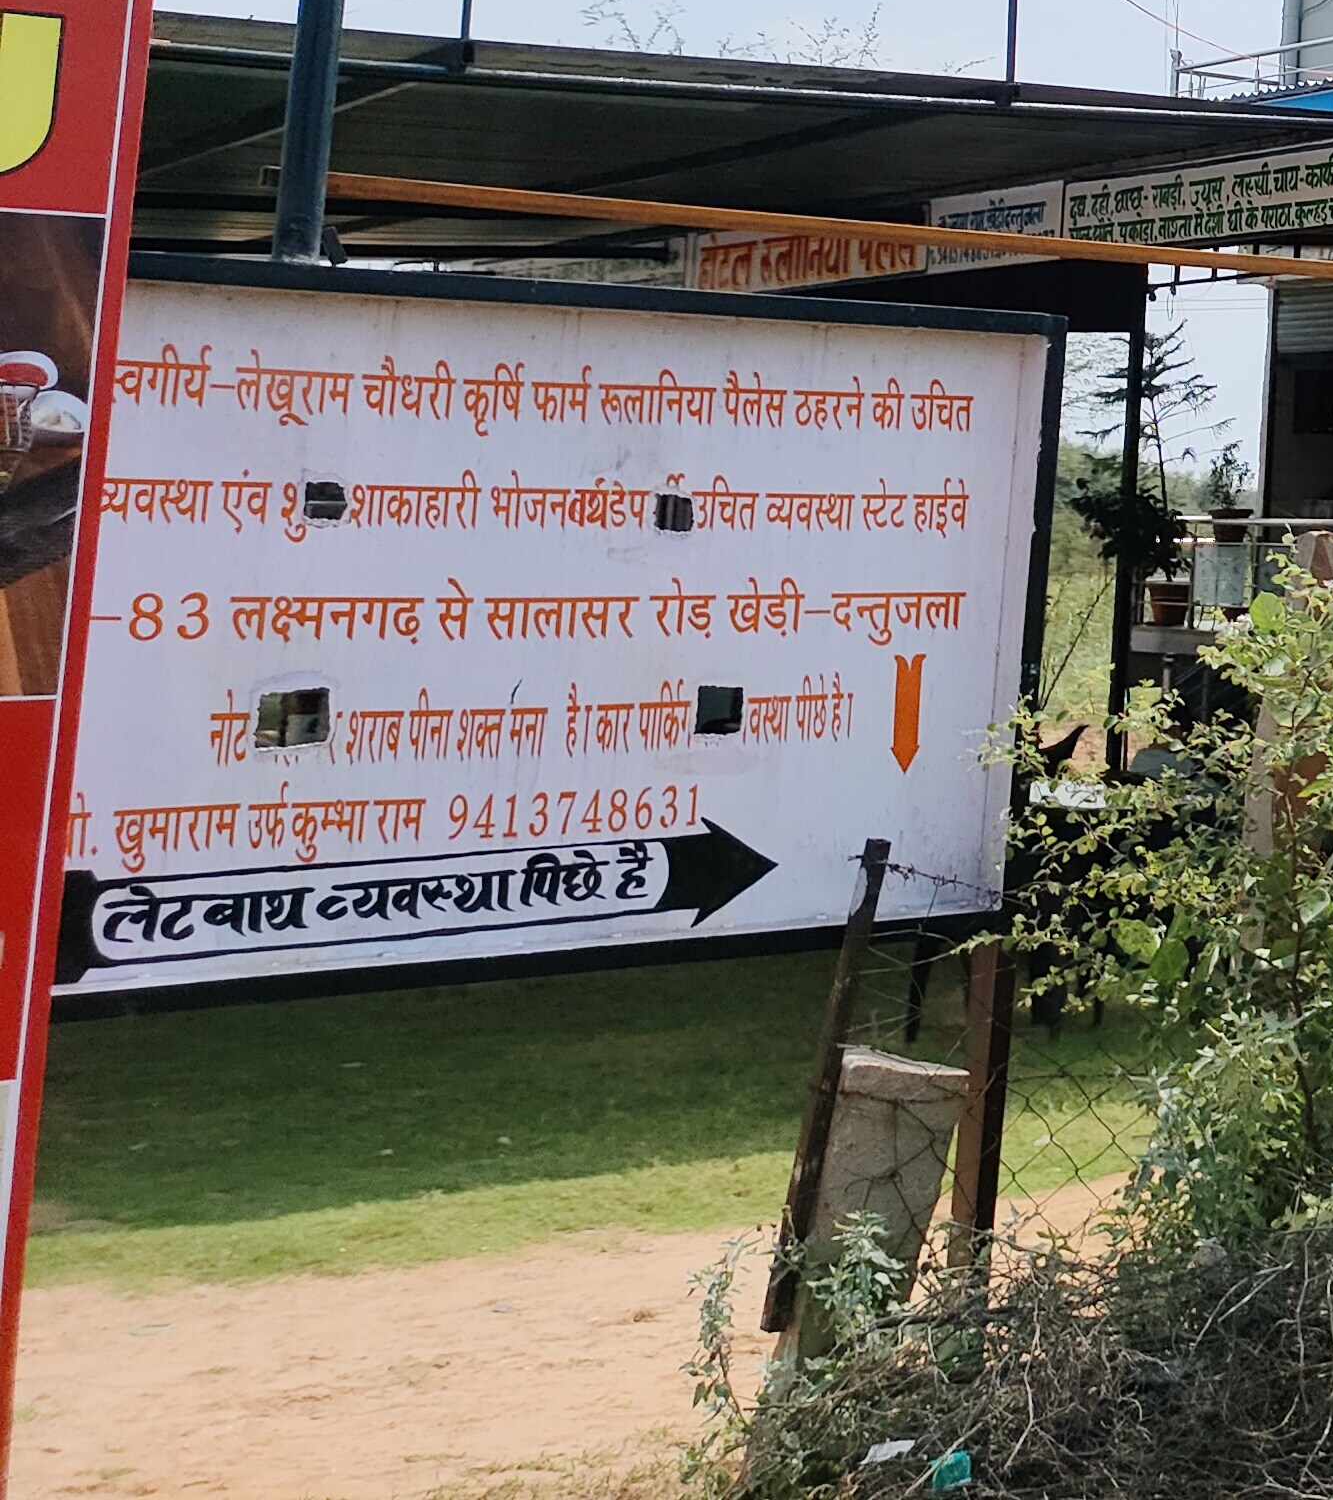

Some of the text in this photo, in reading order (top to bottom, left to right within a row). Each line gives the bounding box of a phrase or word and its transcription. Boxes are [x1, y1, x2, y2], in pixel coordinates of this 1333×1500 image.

[1245, 200, 1259, 229] के
[362, 355, 456, 419] चौधरी
[532, 366, 591, 424] फार्म
[599, 369, 716, 426] रूलानिया
[724, 370, 787, 428] पैलेस
[794, 376, 864, 431] ठहरने
[872, 377, 904, 430] की
[911, 379, 973, 432] उचित
[350, 469, 481, 529] शाकाहारी
[692, 474, 759, 532] उचित
[766, 491, 855, 532] व्यवस्था
[861, 478, 907, 531] स्टेट
[913, 478, 969, 539] हाईवे
[436, 577, 473, 641] से
[485, 596, 639, 640] सालासर
[650, 577, 716, 639] रोड़
[210, 689, 250, 767] नोट
[346, 709, 404, 766] शराब
[410, 688, 453, 763] पीना
[596, 702, 635, 753] कार
[796, 670, 828, 742] पीछे
[113, 803, 241, 873] खुमाराम
[374, 798, 426, 845] राम
[448, 784, 699, 840] 9413748631
[316, 869, 517, 921] व्यवस्था
[615, 841, 654, 900] है
